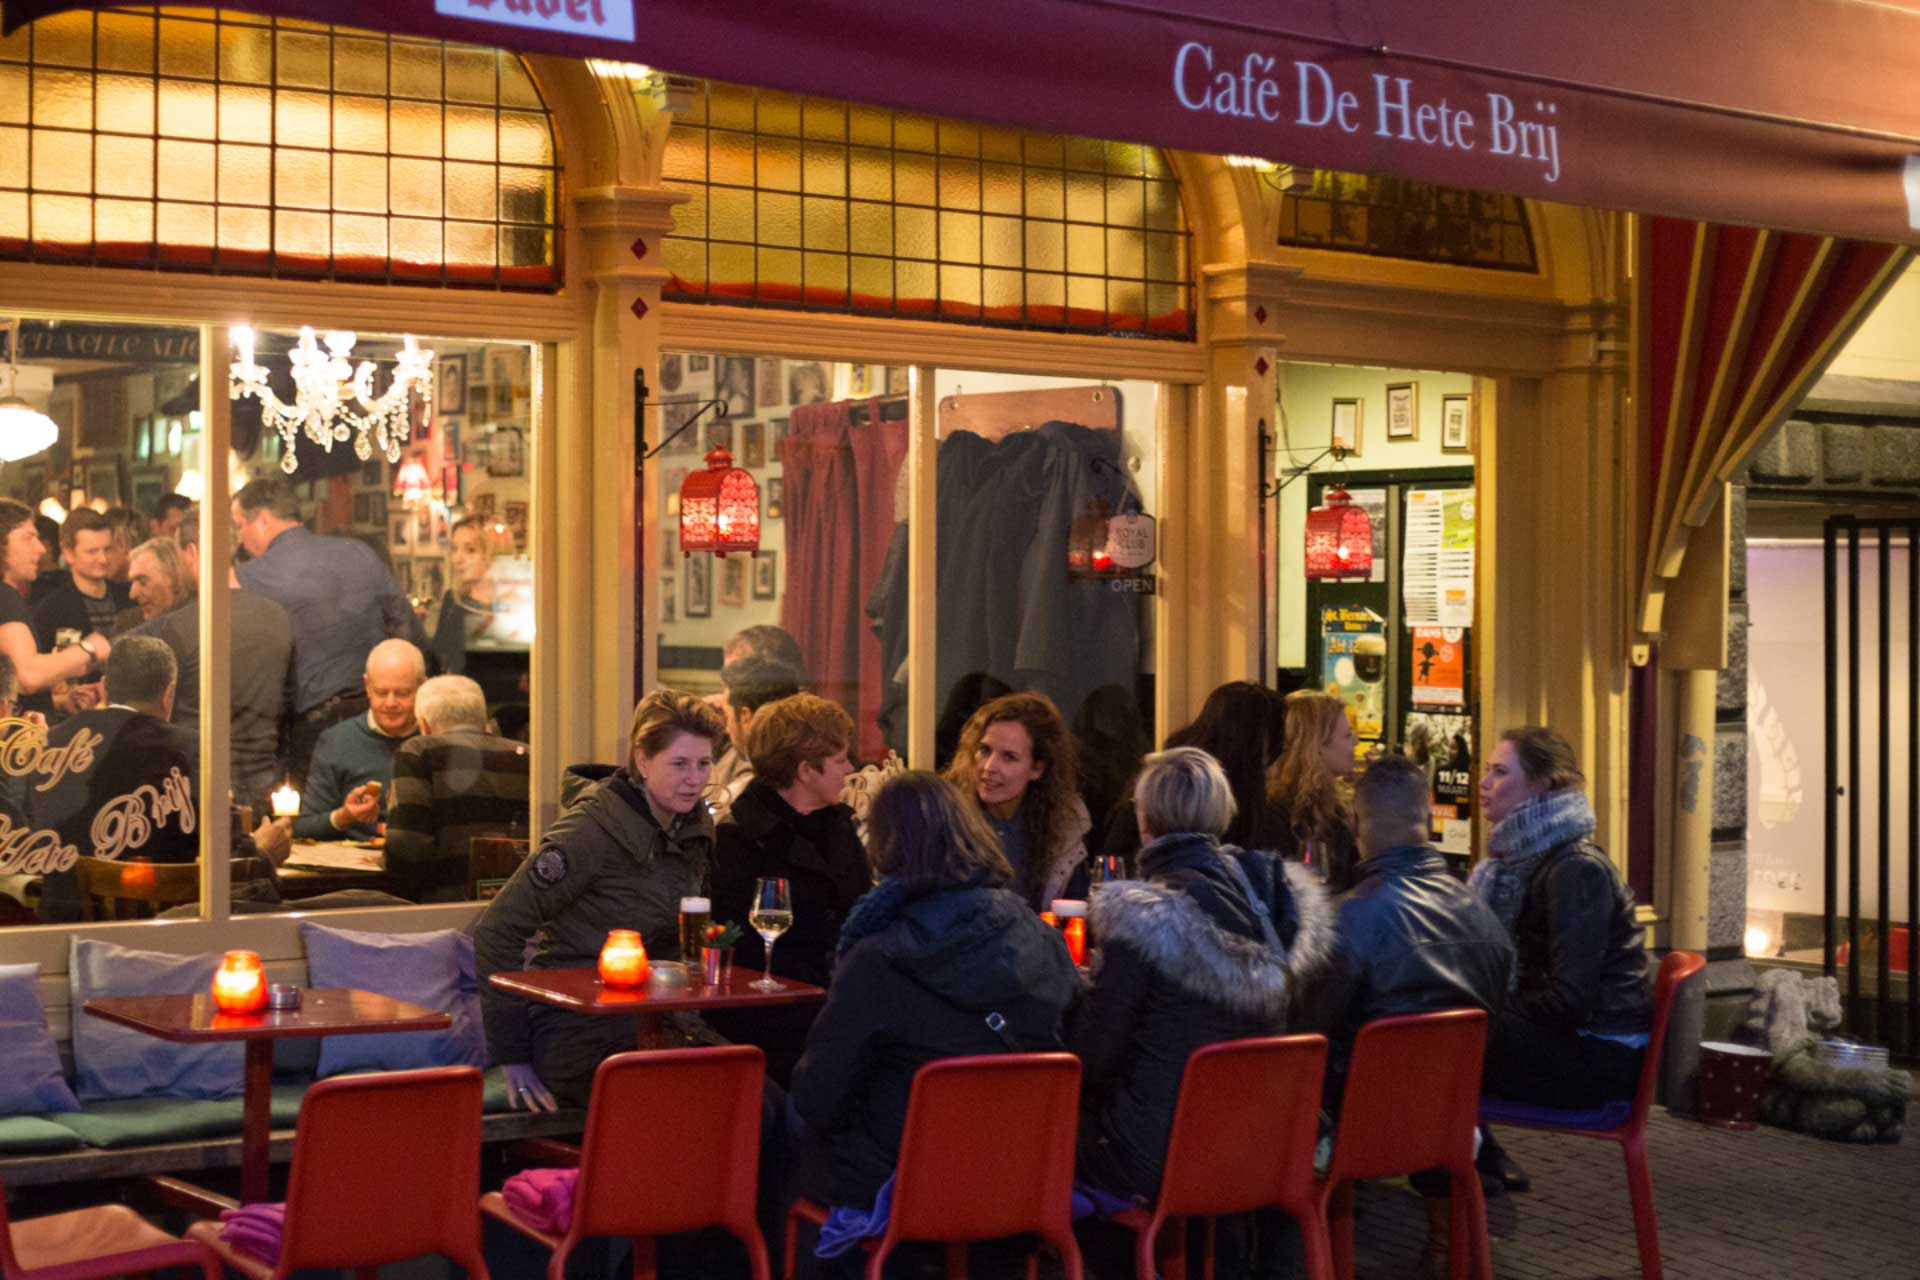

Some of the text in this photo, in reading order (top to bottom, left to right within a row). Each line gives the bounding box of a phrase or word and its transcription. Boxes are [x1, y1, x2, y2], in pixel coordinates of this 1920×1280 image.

[1173, 41, 1560, 182] Café De Hete Brij
[1111, 579, 1152, 592] OPEN
[0, 717, 104, 792] Café
[1438, 769, 1470, 785] 11/12
